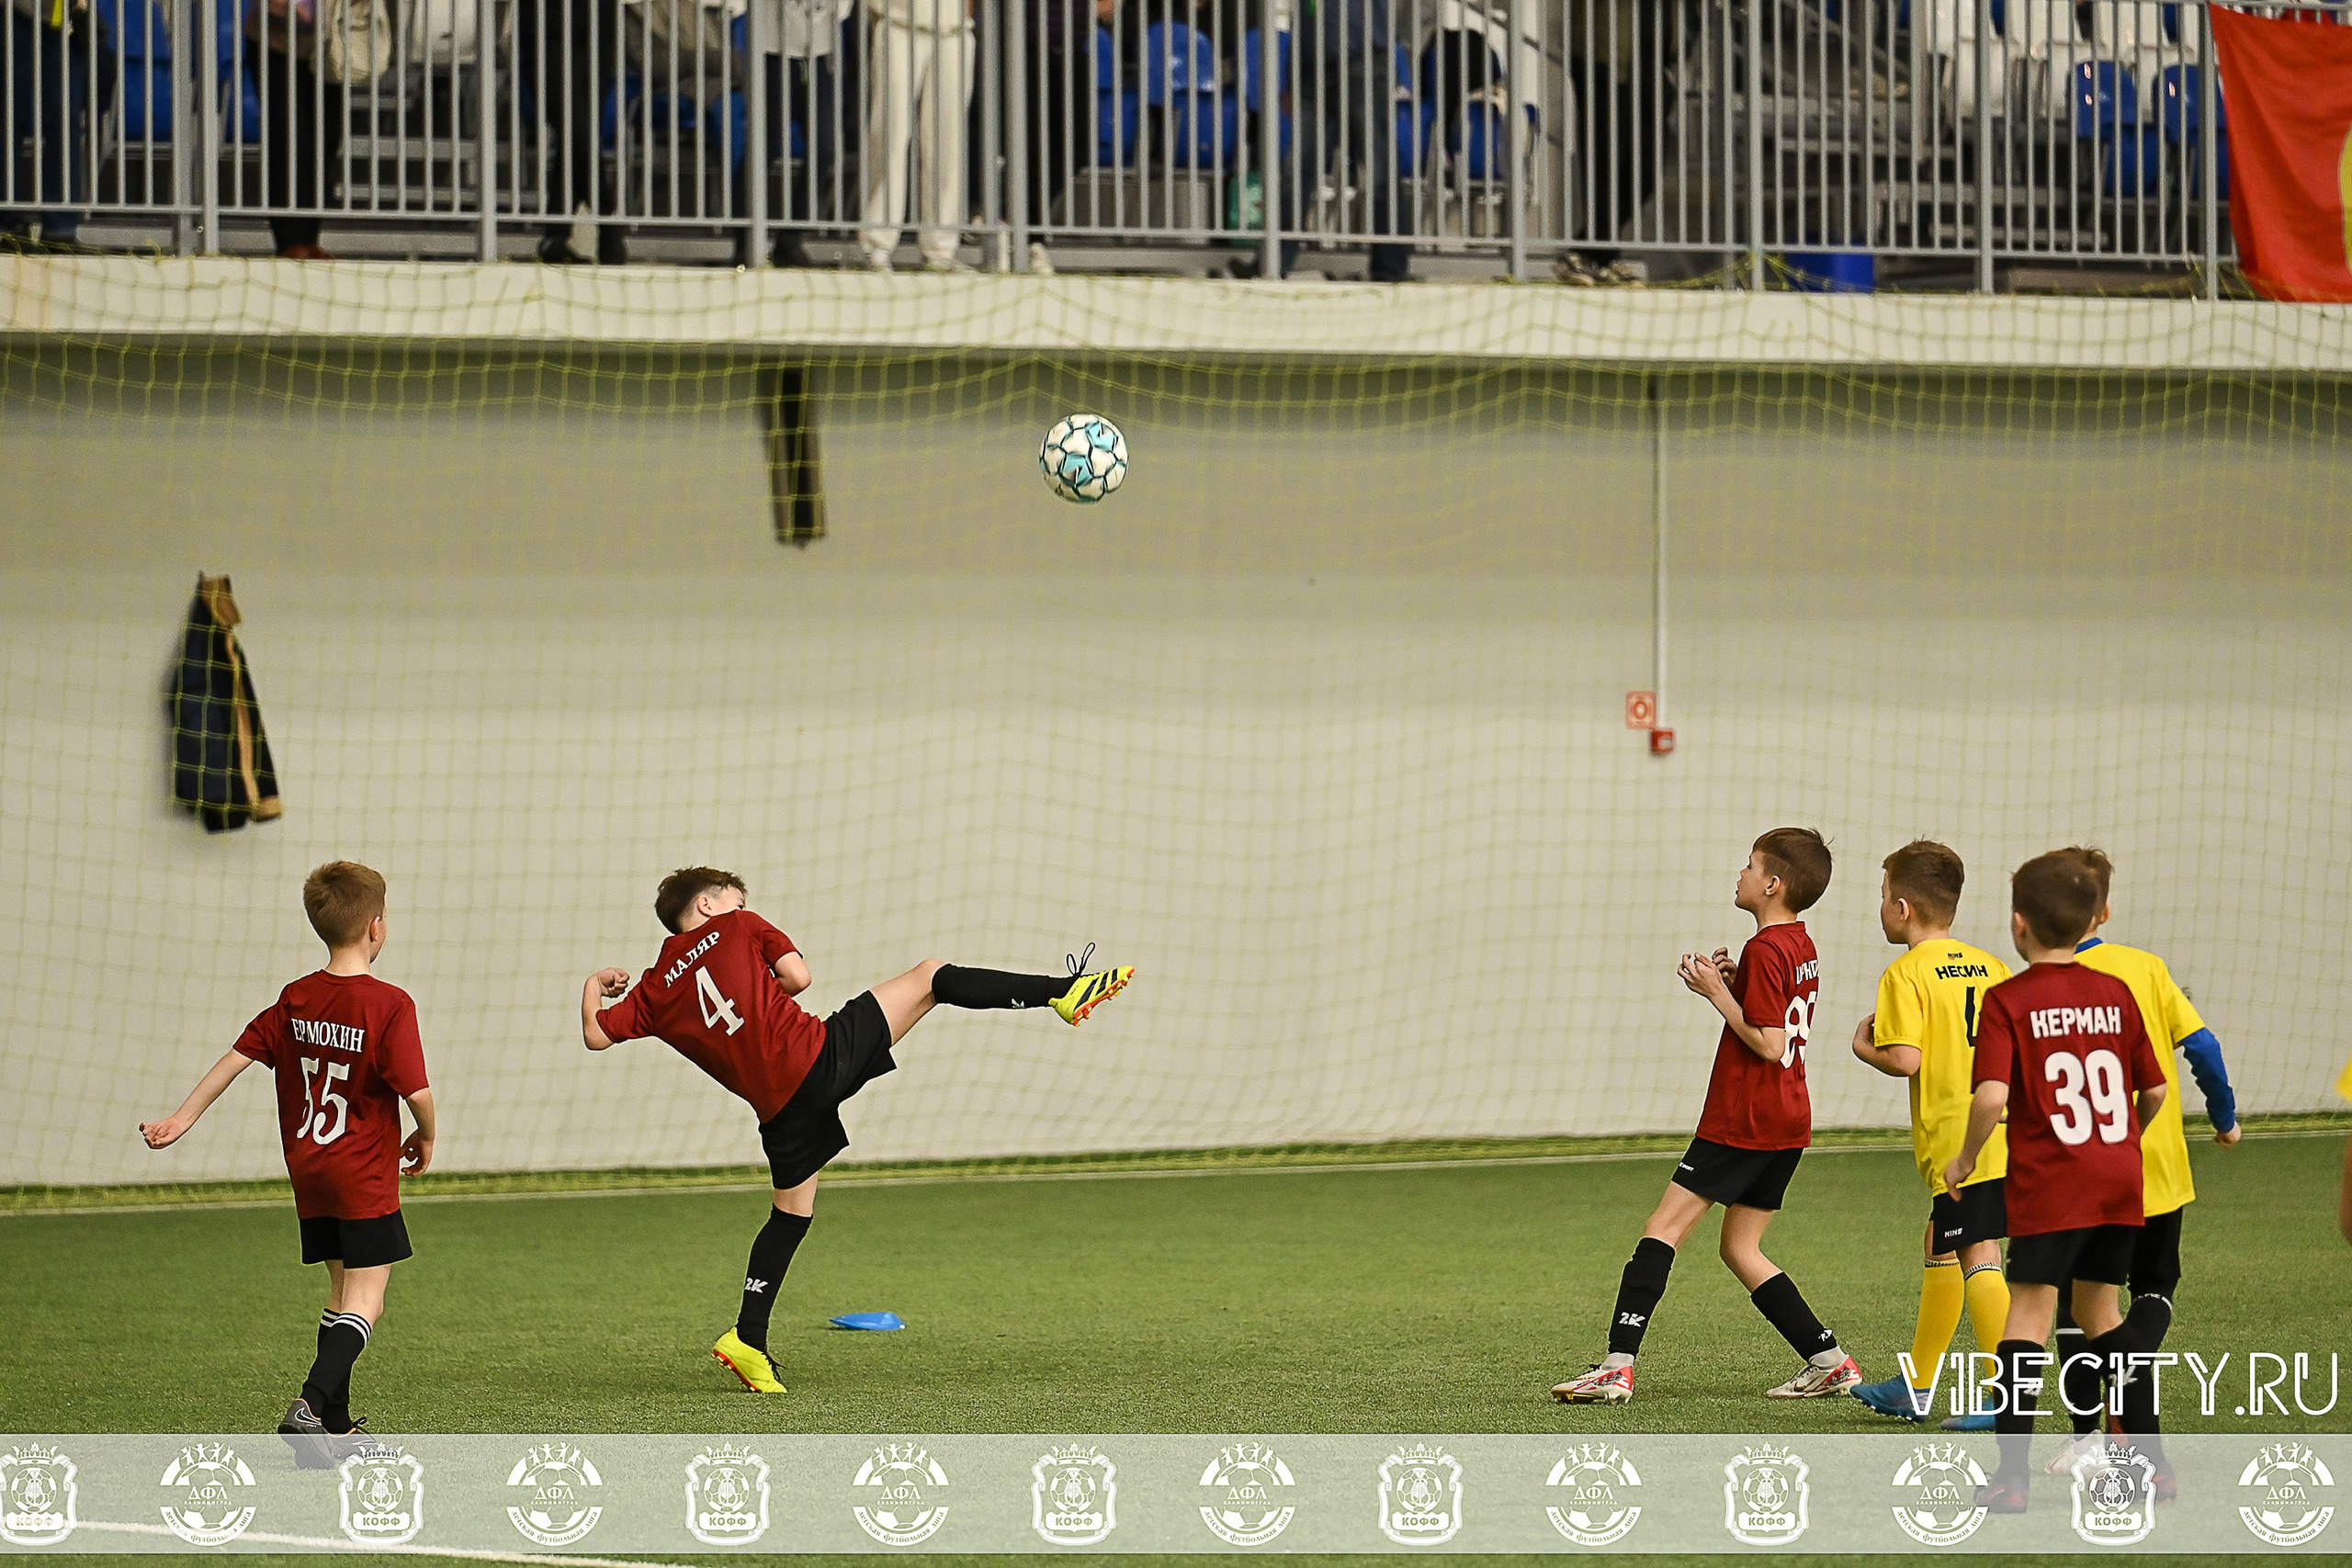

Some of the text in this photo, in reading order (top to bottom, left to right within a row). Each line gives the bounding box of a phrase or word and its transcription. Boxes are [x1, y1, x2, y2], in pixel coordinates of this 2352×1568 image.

[664, 931, 720, 988] МАЛЯР
[1934, 964, 1989, 980] НЕСИН
[695, 965, 745, 1037] 4
[290, 1018, 366, 1054] ЕРМОХИН
[296, 1056, 350, 1145] 55
[2044, 1049, 2129, 1145] 39
[744, 1277, 769, 1293] 2K
